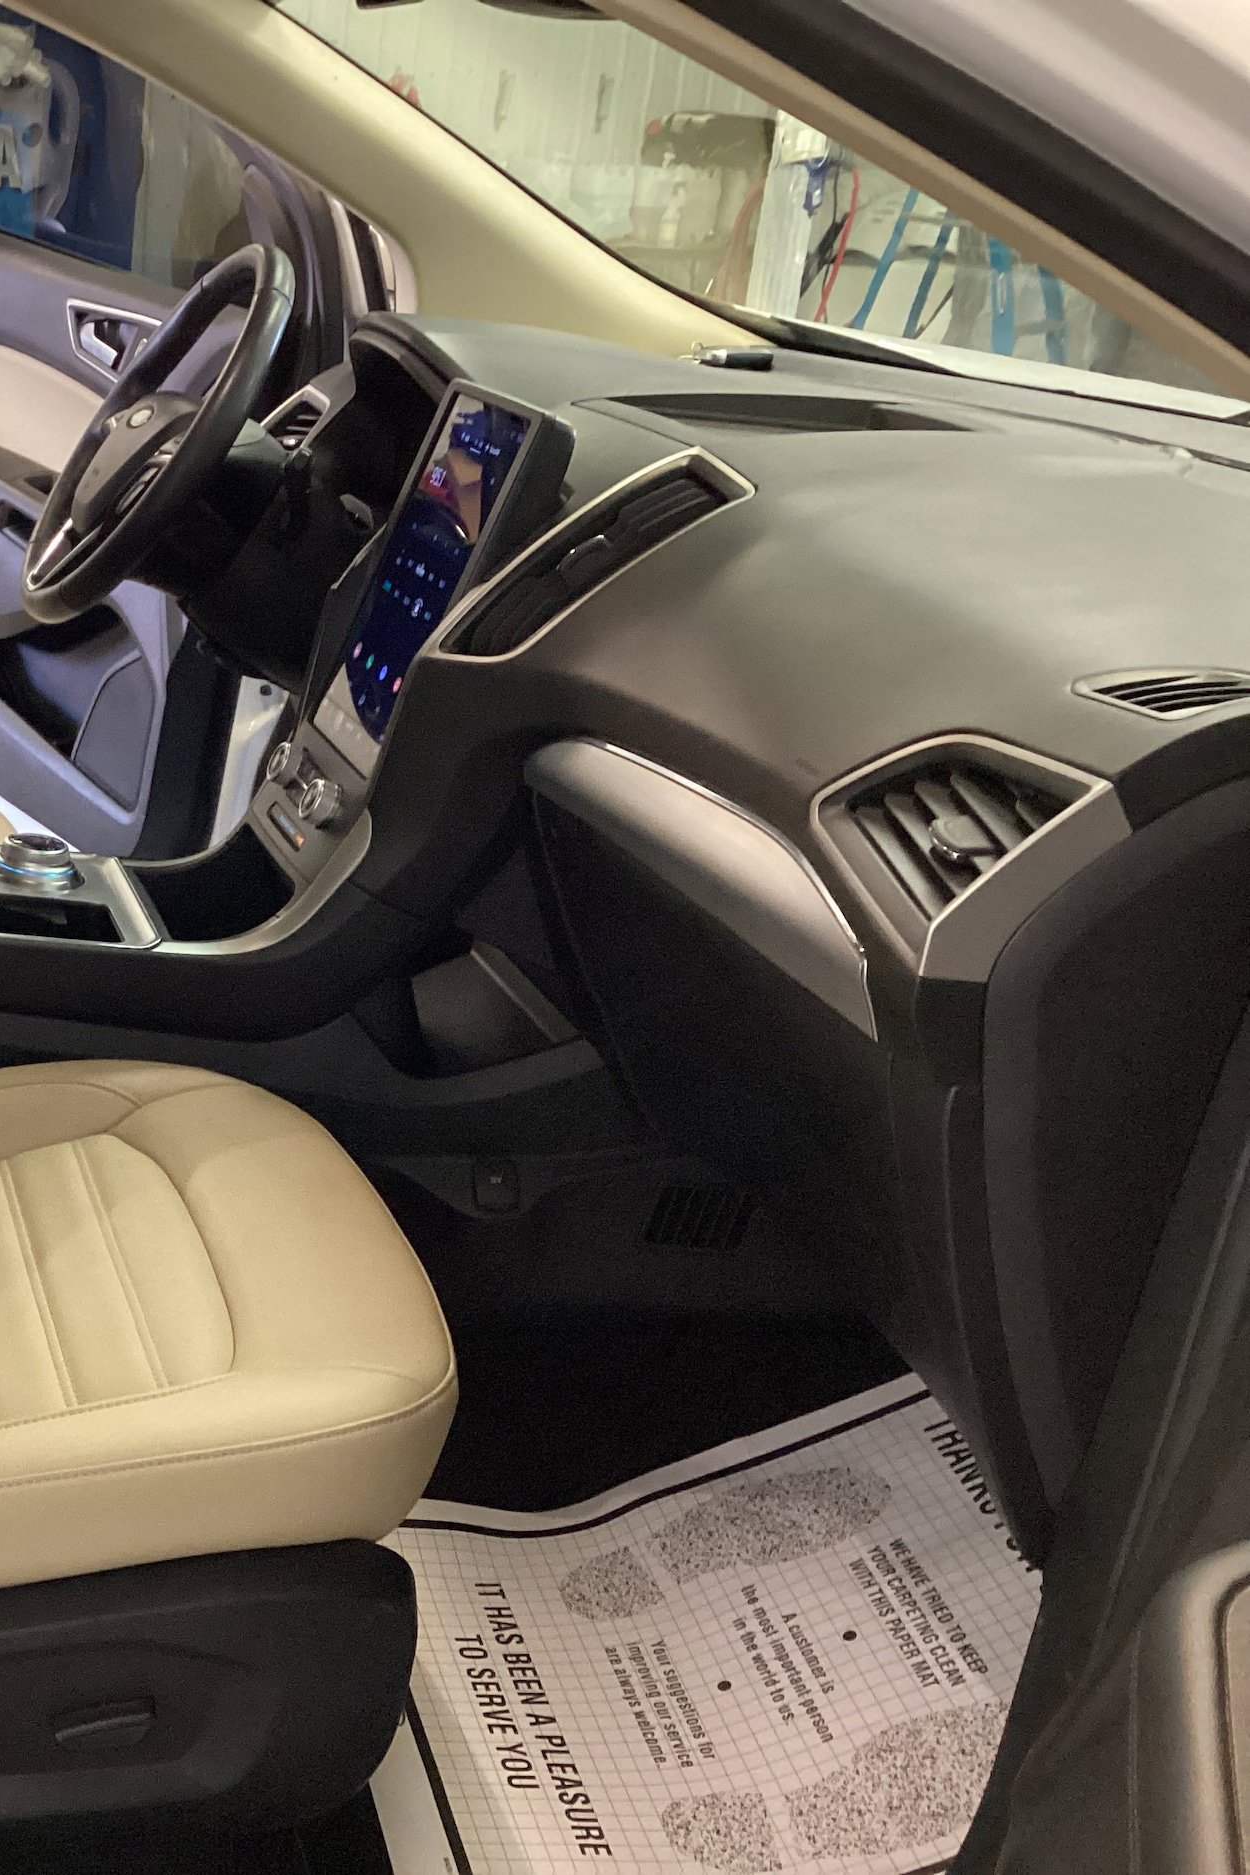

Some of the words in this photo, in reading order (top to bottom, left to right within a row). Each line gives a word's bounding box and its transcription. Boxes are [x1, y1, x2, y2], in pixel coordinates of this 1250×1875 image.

[474, 1582, 507, 1600] IT
[782, 1612, 797, 1624] A
[867, 1545, 896, 1577] YOUR
[887, 1577, 939, 1644] CARPETING
[930, 1645, 967, 1687] CLEAN
[889, 1537, 911, 1558] WE
[901, 1556, 931, 1588] HAVE
[922, 1586, 954, 1624] TRIED
[946, 1624, 967, 1643] TO
[957, 1643, 988, 1674] KEEP
[454, 1634, 489, 1660] TO
[483, 1606, 525, 1645] HAS
[789, 1624, 826, 1679] customer
[849, 1557, 876, 1590] WITH
[868, 1587, 895, 1617] THIS
[886, 1617, 921, 1660] PAPER
[911, 1661, 940, 1688] MAT
[502, 1653, 550, 1705] BEEN
[605, 1646, 622, 1665] are
[614, 1668, 642, 1708] always
[732, 1616, 747, 1631] in
[740, 1631, 758, 1652] the
[752, 1653, 780, 1687] world
[770, 1687, 785, 1702] to
[741, 1583, 759, 1605] the
[752, 1606, 779, 1638] most
[769, 1637, 812, 1697] important
[798, 1698, 833, 1743] person
[820, 1679, 834, 1694] is
[466, 1667, 519, 1735] SERVE
[525, 1711, 557, 1727] A
[626, 1640, 661, 1698] improving
[653, 1701, 672, 1720] our
[664, 1723, 694, 1768] service
[651, 1639, 671, 1666] Your
[663, 1669, 705, 1740] suggestions
[697, 1741, 716, 1760] for
[495, 1742, 541, 1790] YOU
[534, 1733, 613, 1857] PLEASURE
